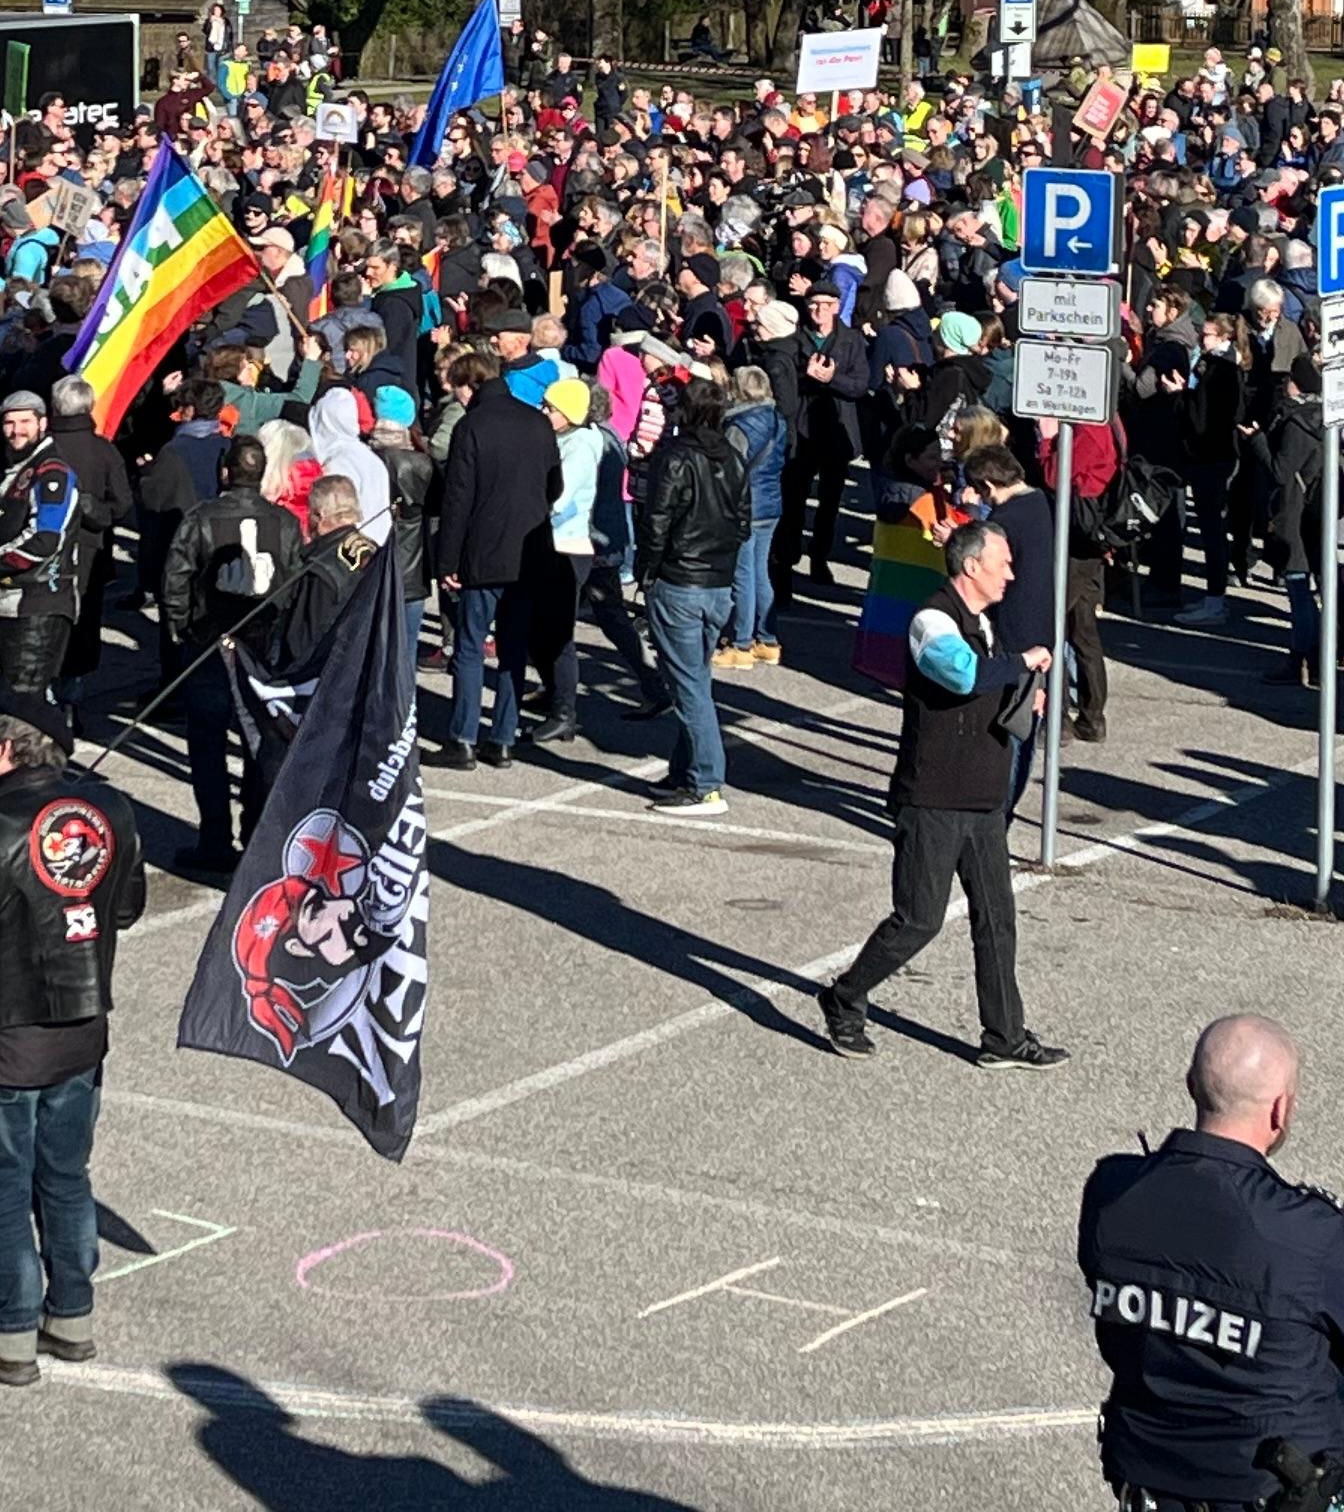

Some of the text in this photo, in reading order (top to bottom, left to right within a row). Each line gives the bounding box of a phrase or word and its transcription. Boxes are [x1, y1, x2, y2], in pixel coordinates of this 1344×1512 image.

[1043, 182, 1092, 258] P
[1054, 292, 1077, 306] mit
[1027, 307, 1104, 325] Parkschein
[1043, 350, 1081, 365] Mo-Fr
[1036, 382, 1052, 396] Sa
[1093, 1278, 1263, 1359] POLIZEI
